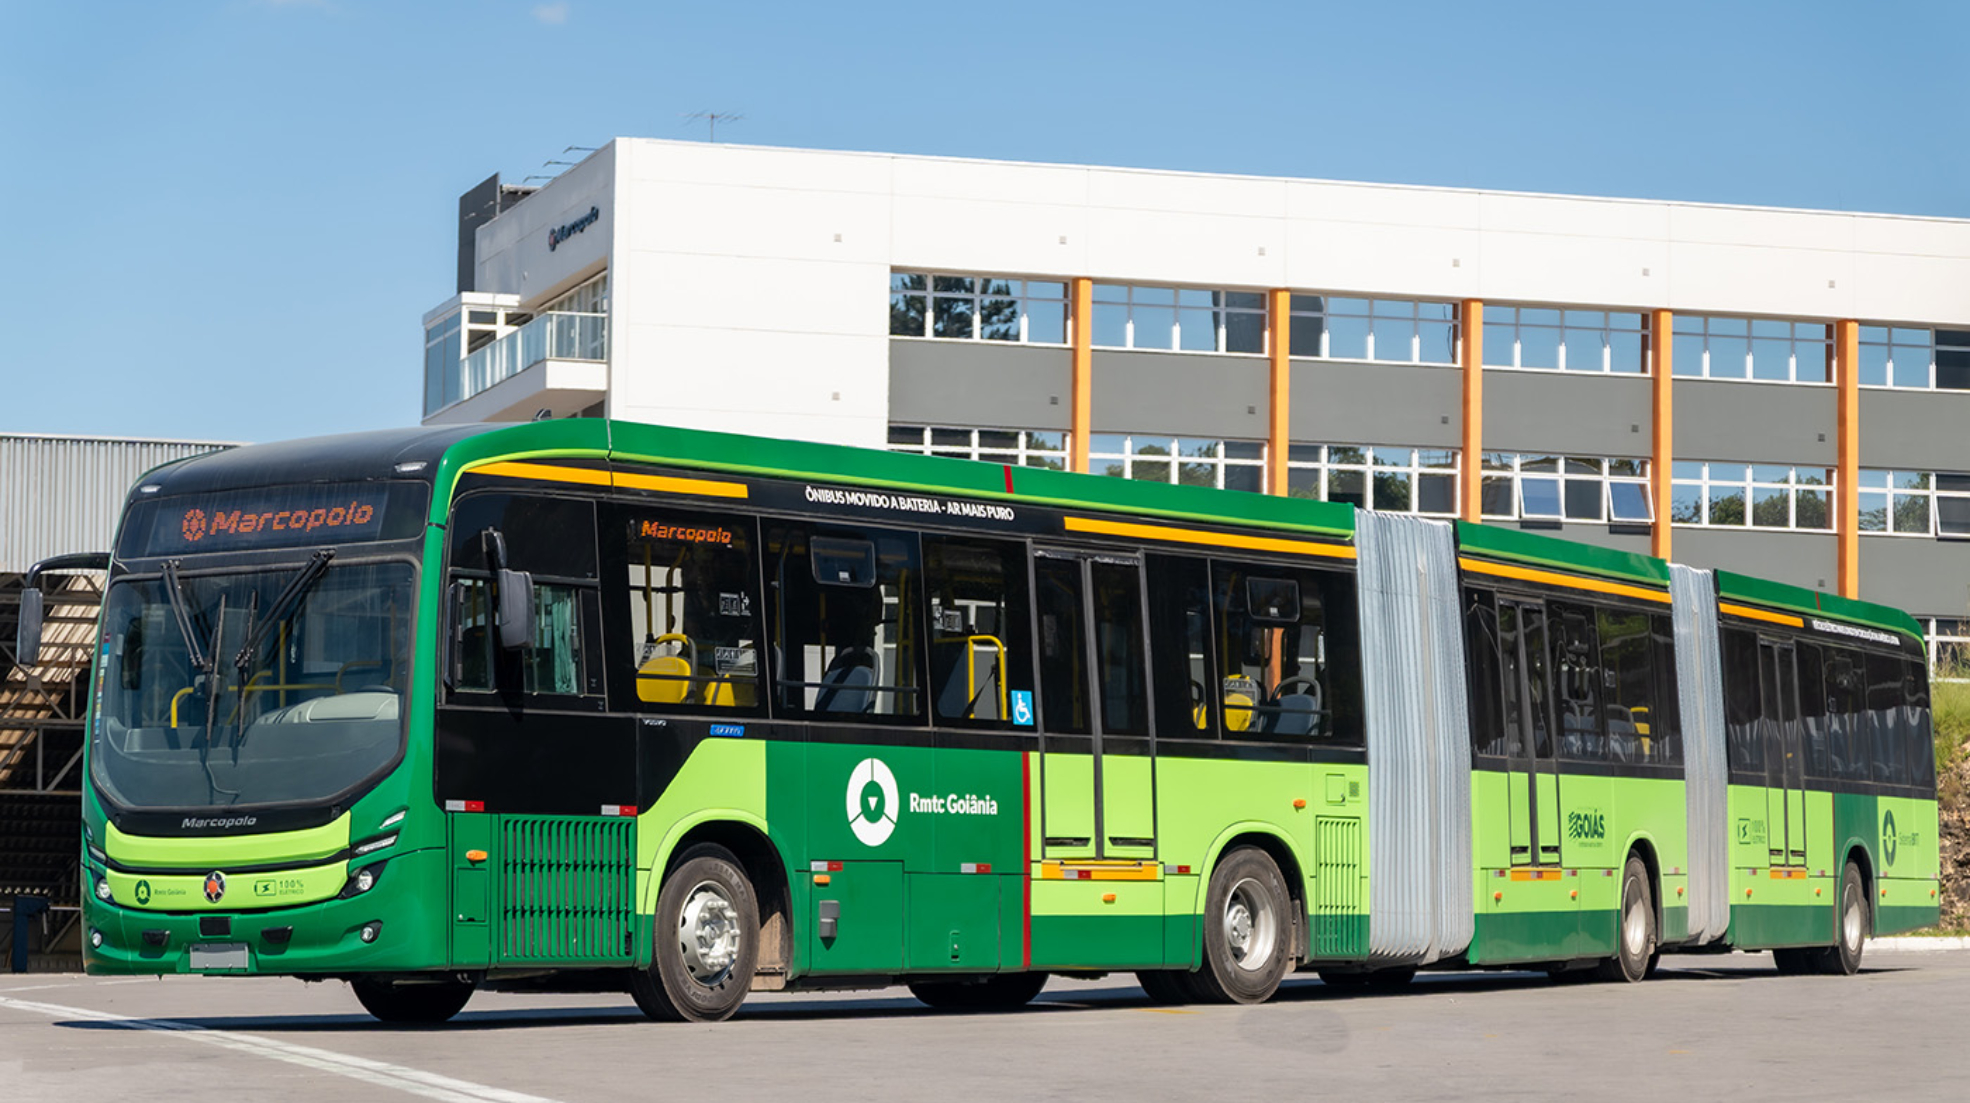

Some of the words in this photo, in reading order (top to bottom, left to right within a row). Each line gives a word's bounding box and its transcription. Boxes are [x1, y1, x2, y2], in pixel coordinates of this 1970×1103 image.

[805, 485, 845, 505] ÔNIBUS
[845, 491, 890, 508] MOVIDO
[890, 496, 899, 509] A
[899, 497, 941, 513] BATERIA
[947, 501, 961, 515] AR
[961, 502, 987, 518] MAIS
[987, 506, 1015, 521] PURO
[209, 501, 373, 535] Marcopolo
[641, 520, 732, 543] Marcopolo
[910, 792, 945, 813] Rmtc
[946, 793, 998, 815] Goiânia
[181, 815, 257, 829] Marcopolo
[1576, 808, 1605, 839] GOIÁS
[279, 879, 304, 888] 100%
